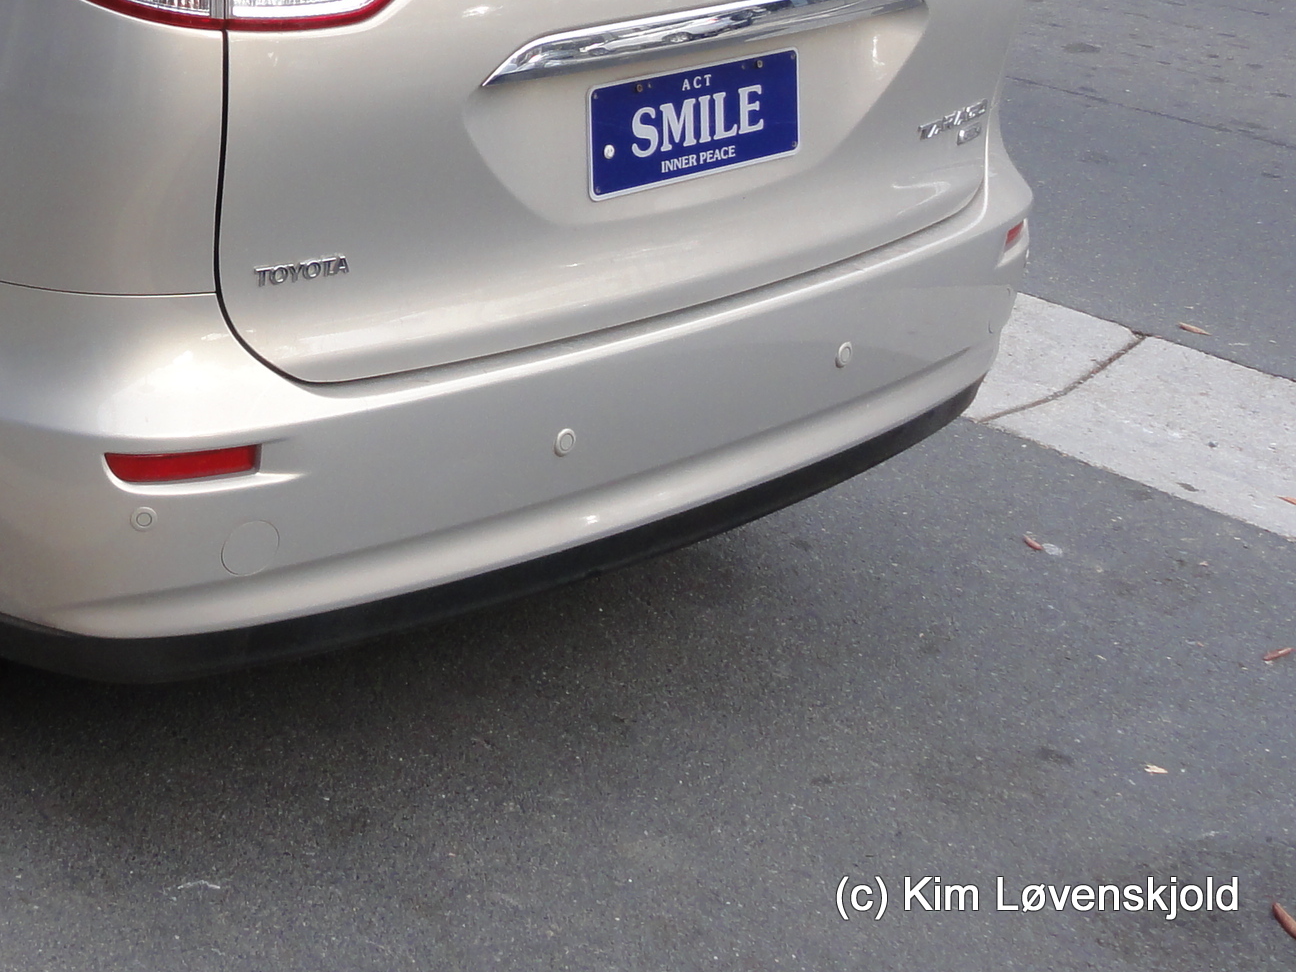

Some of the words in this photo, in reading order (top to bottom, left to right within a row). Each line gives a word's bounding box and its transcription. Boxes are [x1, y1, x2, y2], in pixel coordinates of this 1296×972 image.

[682, 74, 712, 91] ACT
[631, 84, 765, 158] SMILE
[661, 154, 697, 173] INNER
[699, 145, 736, 165] PEACE
[254, 254, 349, 287] TOYOTA
